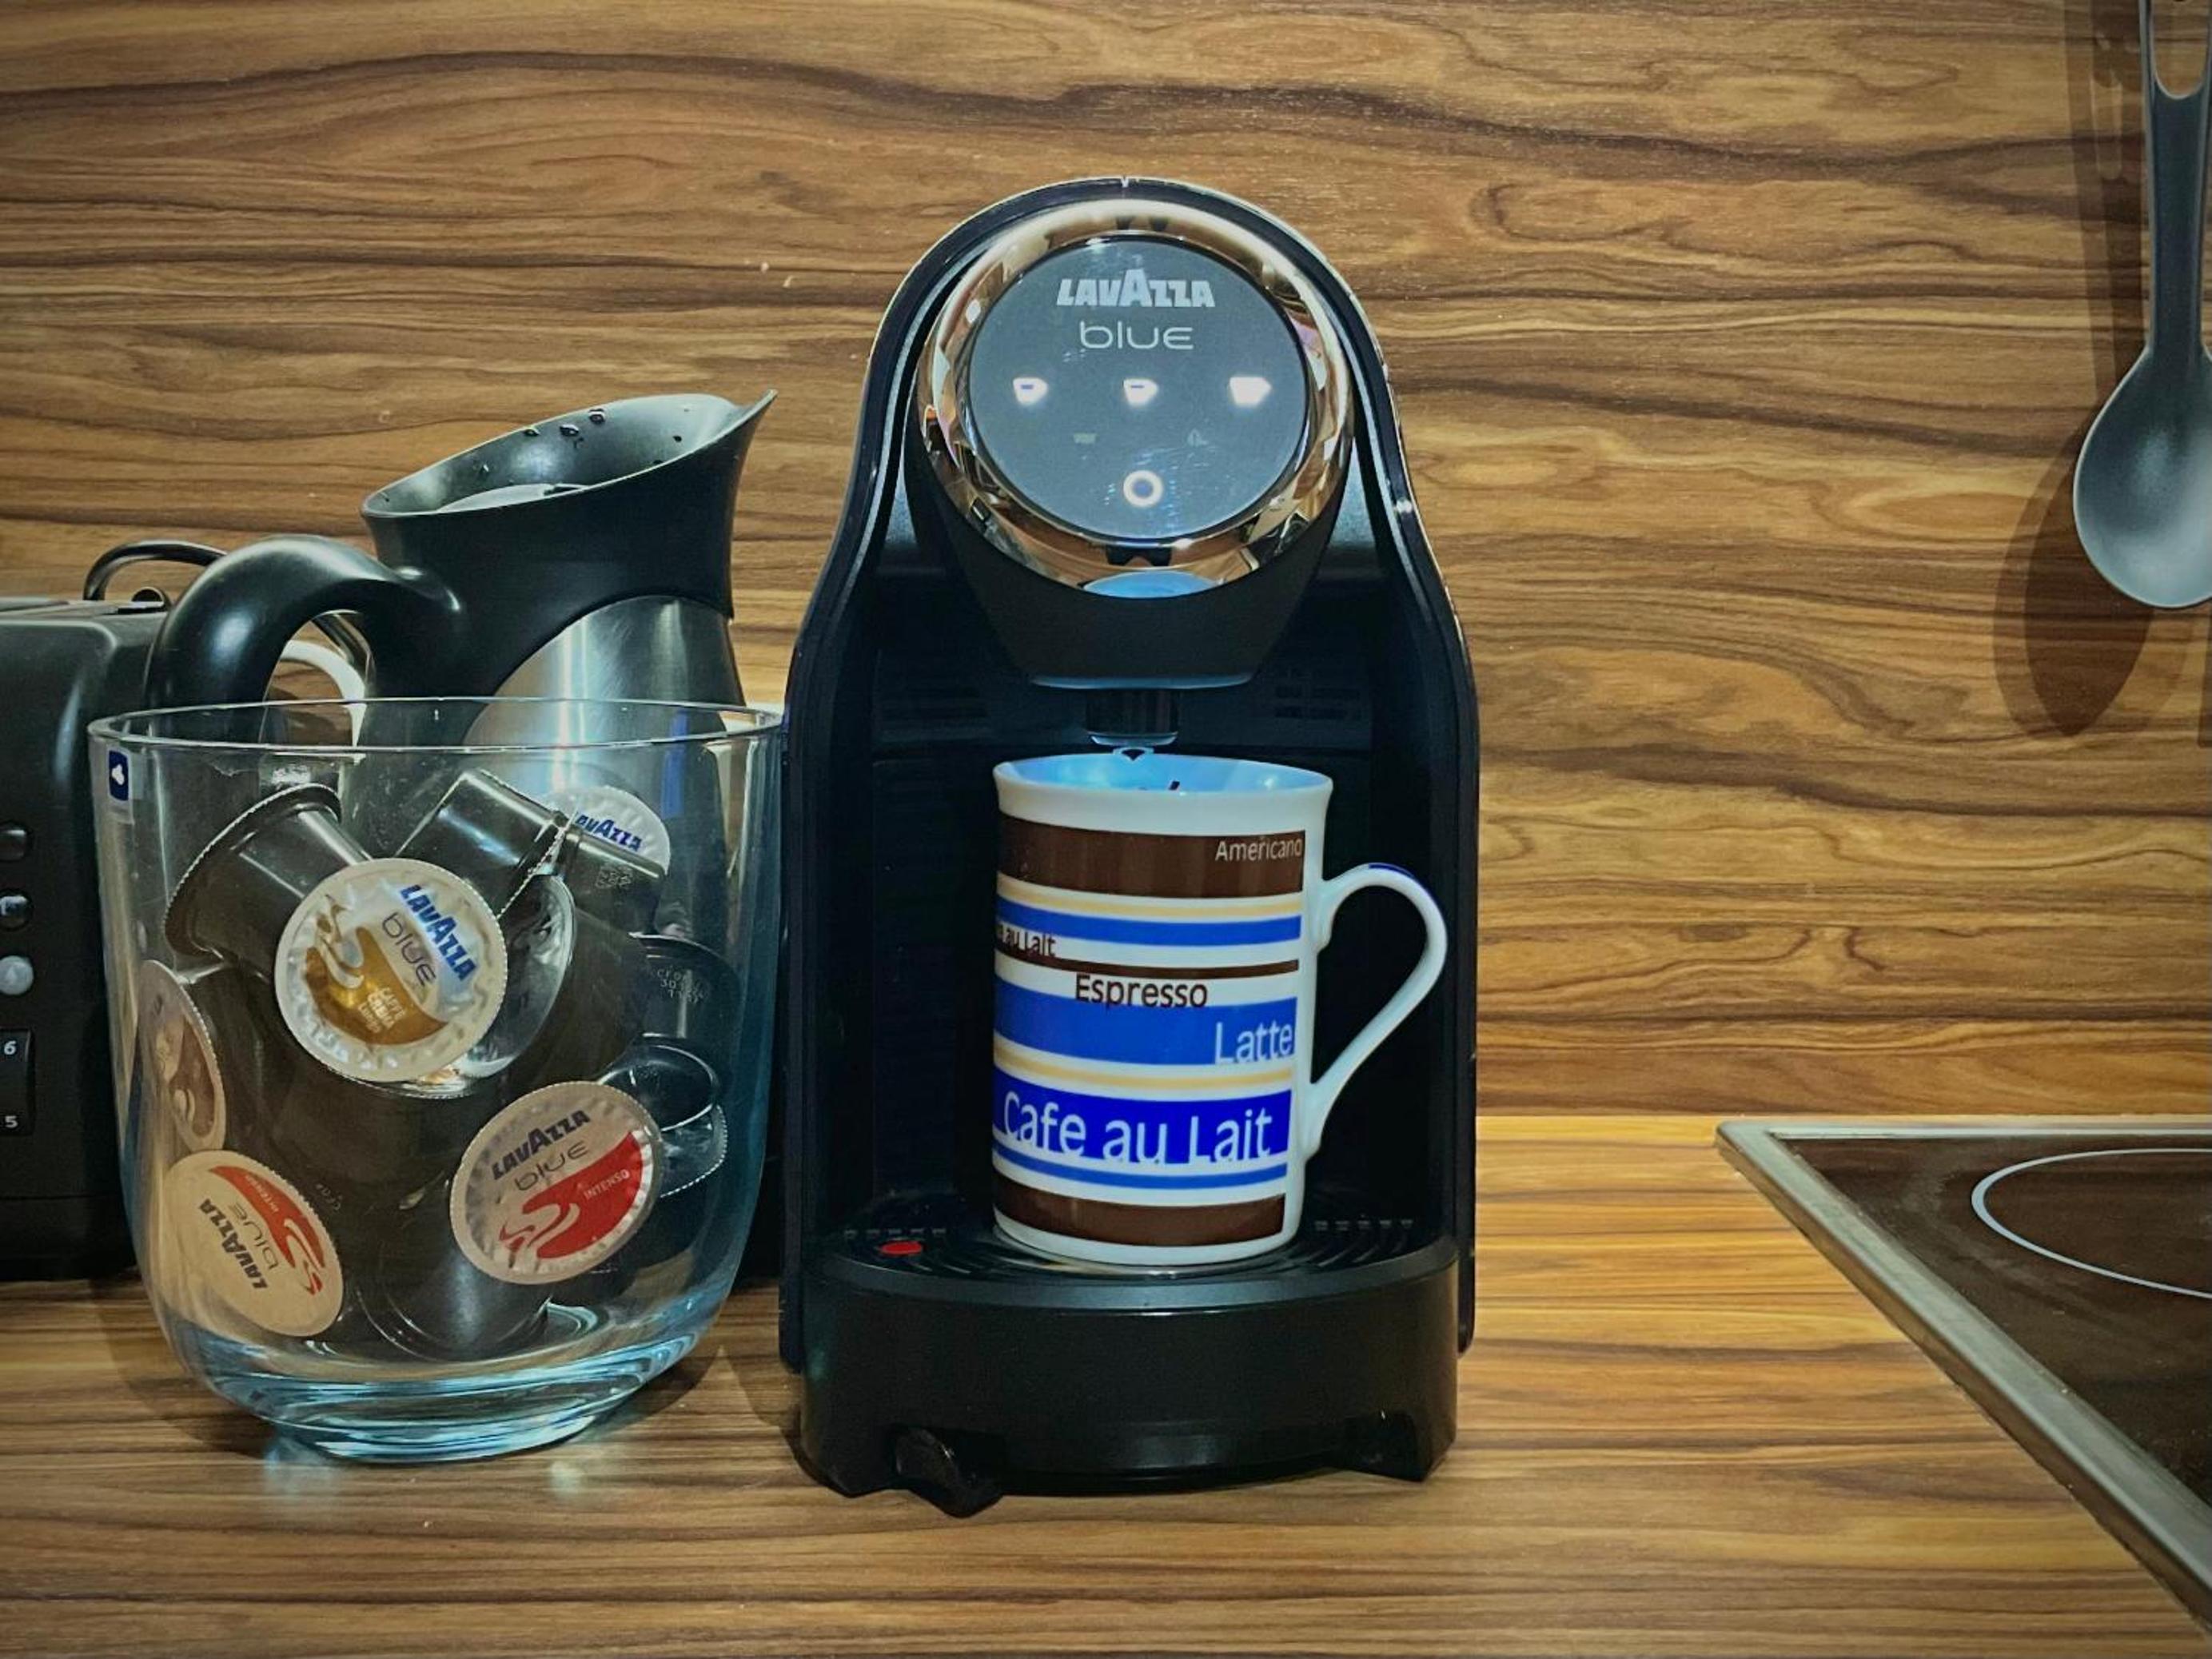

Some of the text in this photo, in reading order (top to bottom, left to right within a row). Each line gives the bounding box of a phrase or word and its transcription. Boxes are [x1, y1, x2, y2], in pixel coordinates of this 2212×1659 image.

[1056, 268, 1216, 308] LAVAZZA
[1080, 321, 1194, 349] blue
[573, 812, 642, 852] AVAZZA
[1215, 836, 1302, 861] Americano
[382, 911, 436, 987] blue
[401, 884, 476, 982] LAVAZZA
[1075, 974, 1208, 1010] Espresso
[4, 1040, 16, 1055] 6
[1215, 1020, 1293, 1063] Latte
[5, 1115, 18, 1128] 5
[1004, 1091, 1273, 1164] Cafe au Lait
[492, 1110, 591, 1180] LAVAZZA
[514, 1140, 589, 1190] blue
[584, 1168, 631, 1199] INTENSO
[198, 1198, 268, 1289] LAVAZZA
[229, 1202, 279, 1270] blue
